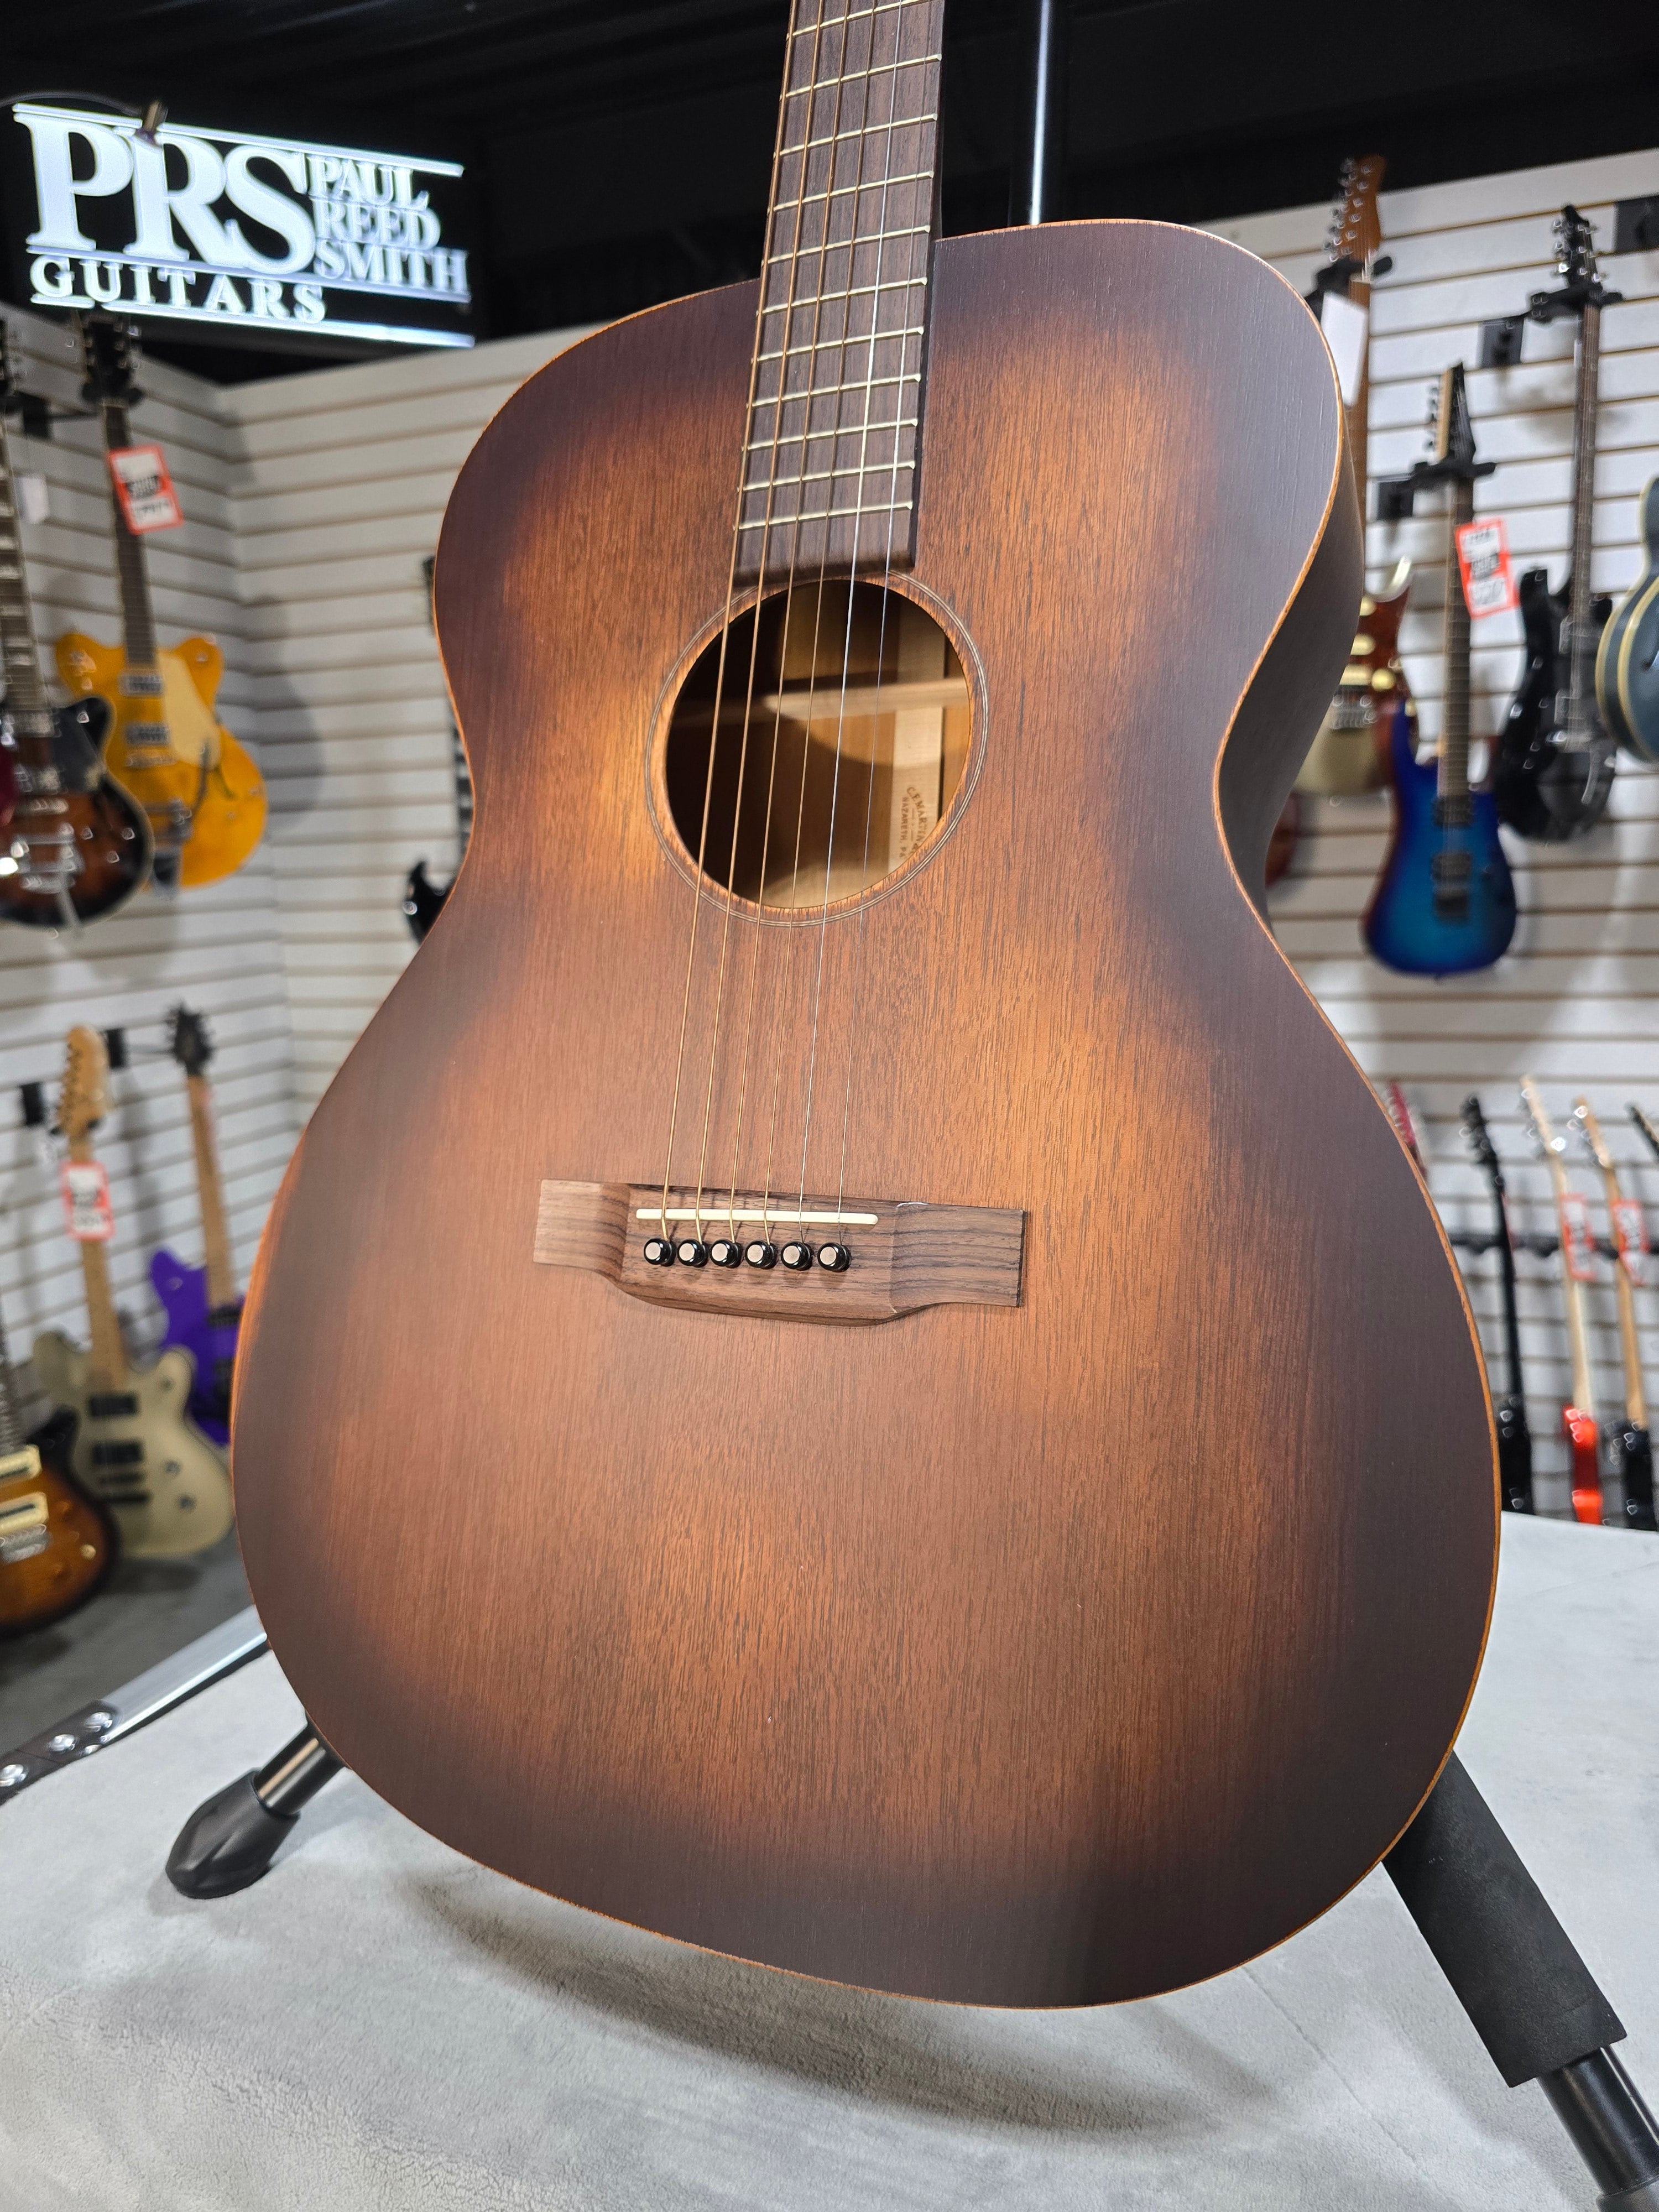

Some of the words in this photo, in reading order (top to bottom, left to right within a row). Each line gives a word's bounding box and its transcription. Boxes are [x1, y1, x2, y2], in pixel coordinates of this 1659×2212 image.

[13, 112, 317, 276] PRS
[306, 154, 430, 211] PAUL
[309, 195, 441, 251] REED
[30, 255, 327, 324] GUITARS
[313, 238, 470, 295] SMITH
